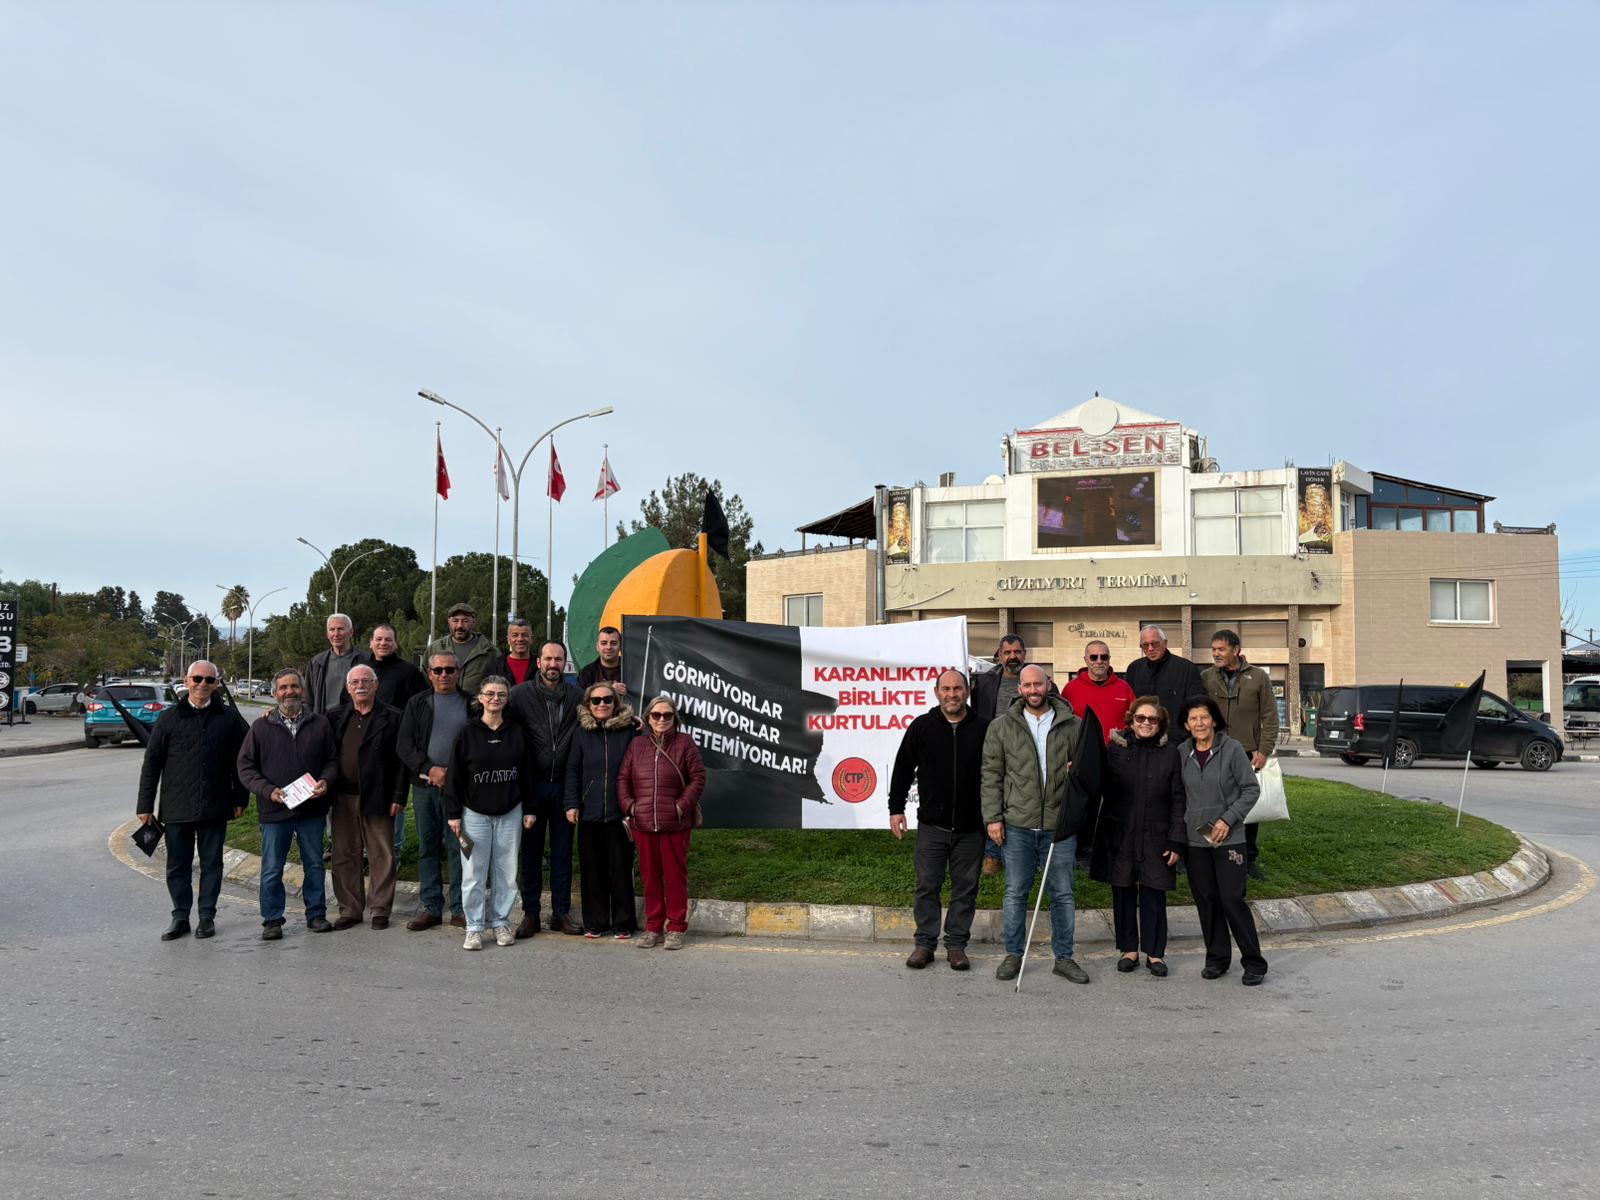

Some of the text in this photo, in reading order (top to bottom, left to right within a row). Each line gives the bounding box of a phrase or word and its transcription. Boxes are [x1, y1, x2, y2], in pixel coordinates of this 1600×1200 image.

[997, 575, 1087, 591] GÜZELYURT
[662, 660, 783, 720] GÖRMÜYORLAR
[838, 687, 926, 706] BİRLİKTE
[844, 773, 864, 784] CTP
